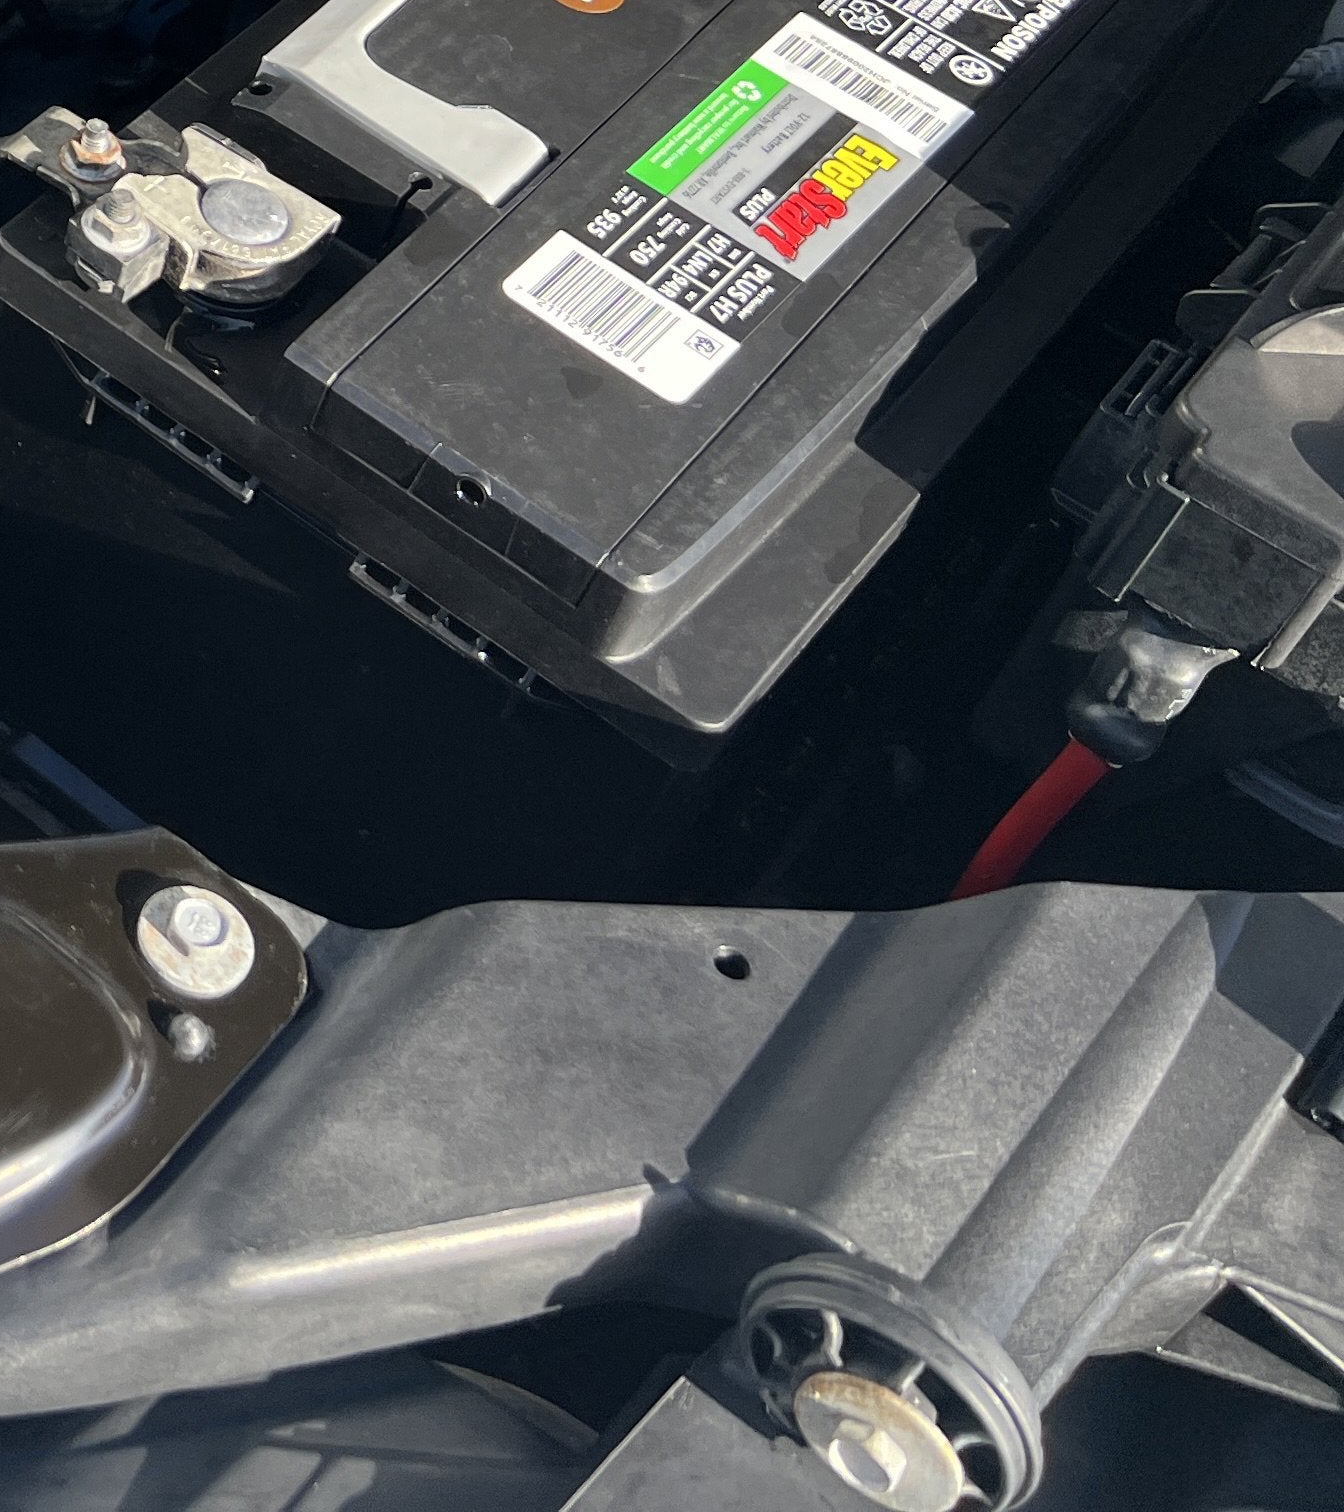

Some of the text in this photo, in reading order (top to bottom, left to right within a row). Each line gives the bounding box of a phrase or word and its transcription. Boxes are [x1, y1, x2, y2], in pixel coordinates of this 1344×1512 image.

[740, 187, 773, 221] PLUS
[753, 133, 899, 260] EverStart
[583, 207, 624, 240] 935
[626, 233, 667, 267] 750
[703, 232, 731, 254] H7
[680, 249, 713, 277] LN4
[656, 271, 690, 300] 94R
[704, 261, 772, 323] PLUS H7
[582, 326, 623, 358] 91756
